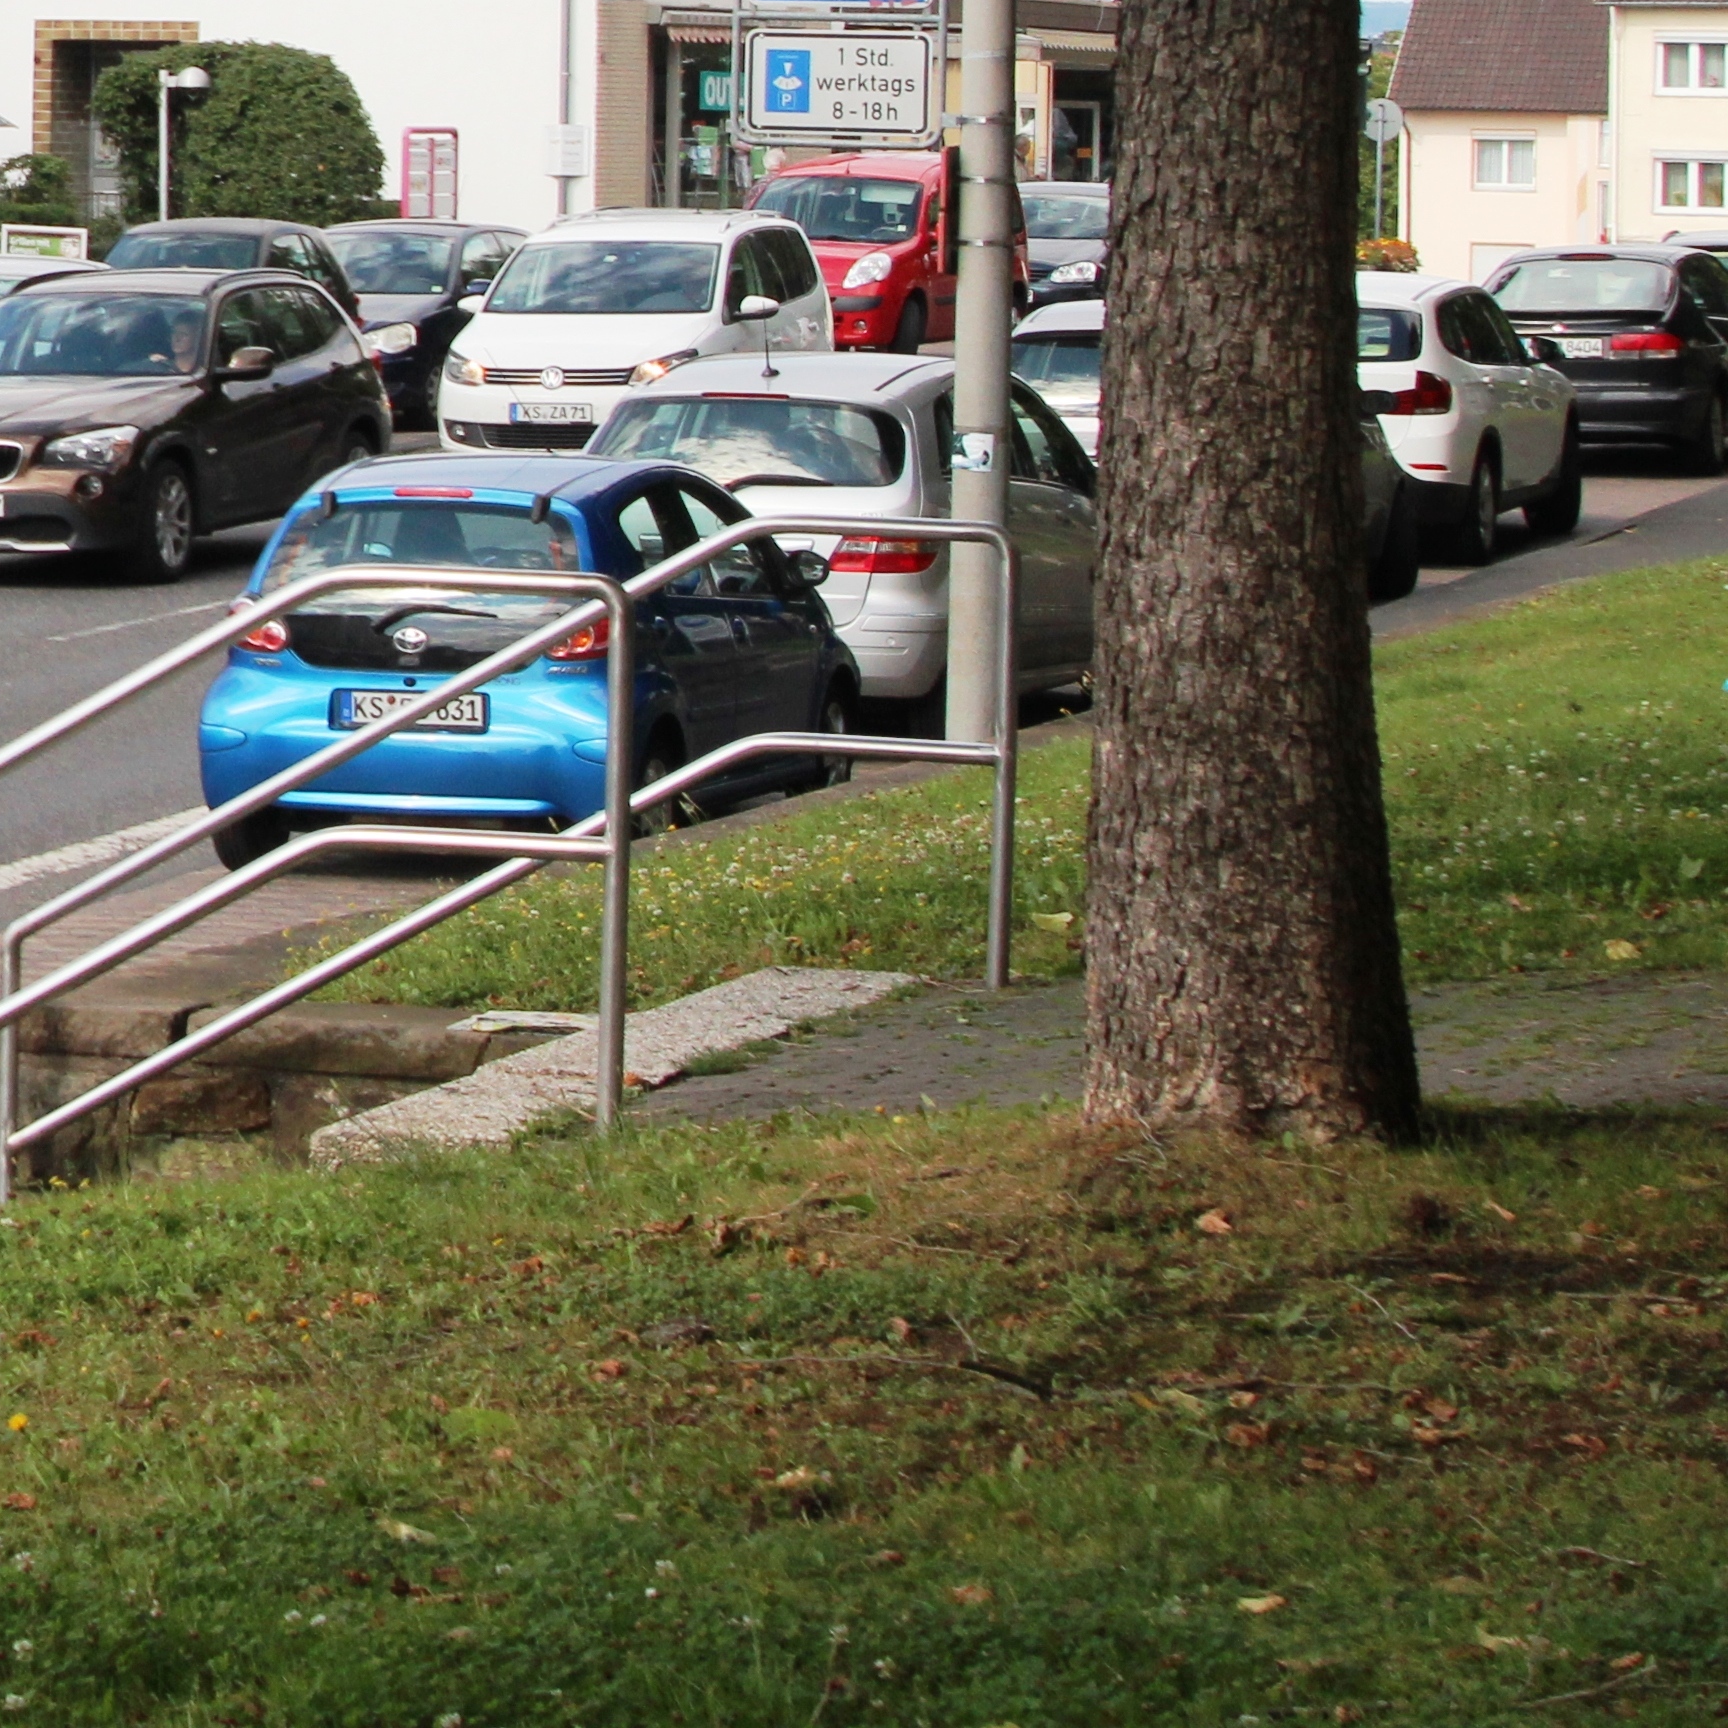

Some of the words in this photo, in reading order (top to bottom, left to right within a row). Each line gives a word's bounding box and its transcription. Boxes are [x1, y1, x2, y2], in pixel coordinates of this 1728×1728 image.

[838, 48, 844, 66] 1
[856, 47, 894, 67] Std.
[816, 73, 916, 97] werktags
[353, 696, 384, 719] KS
